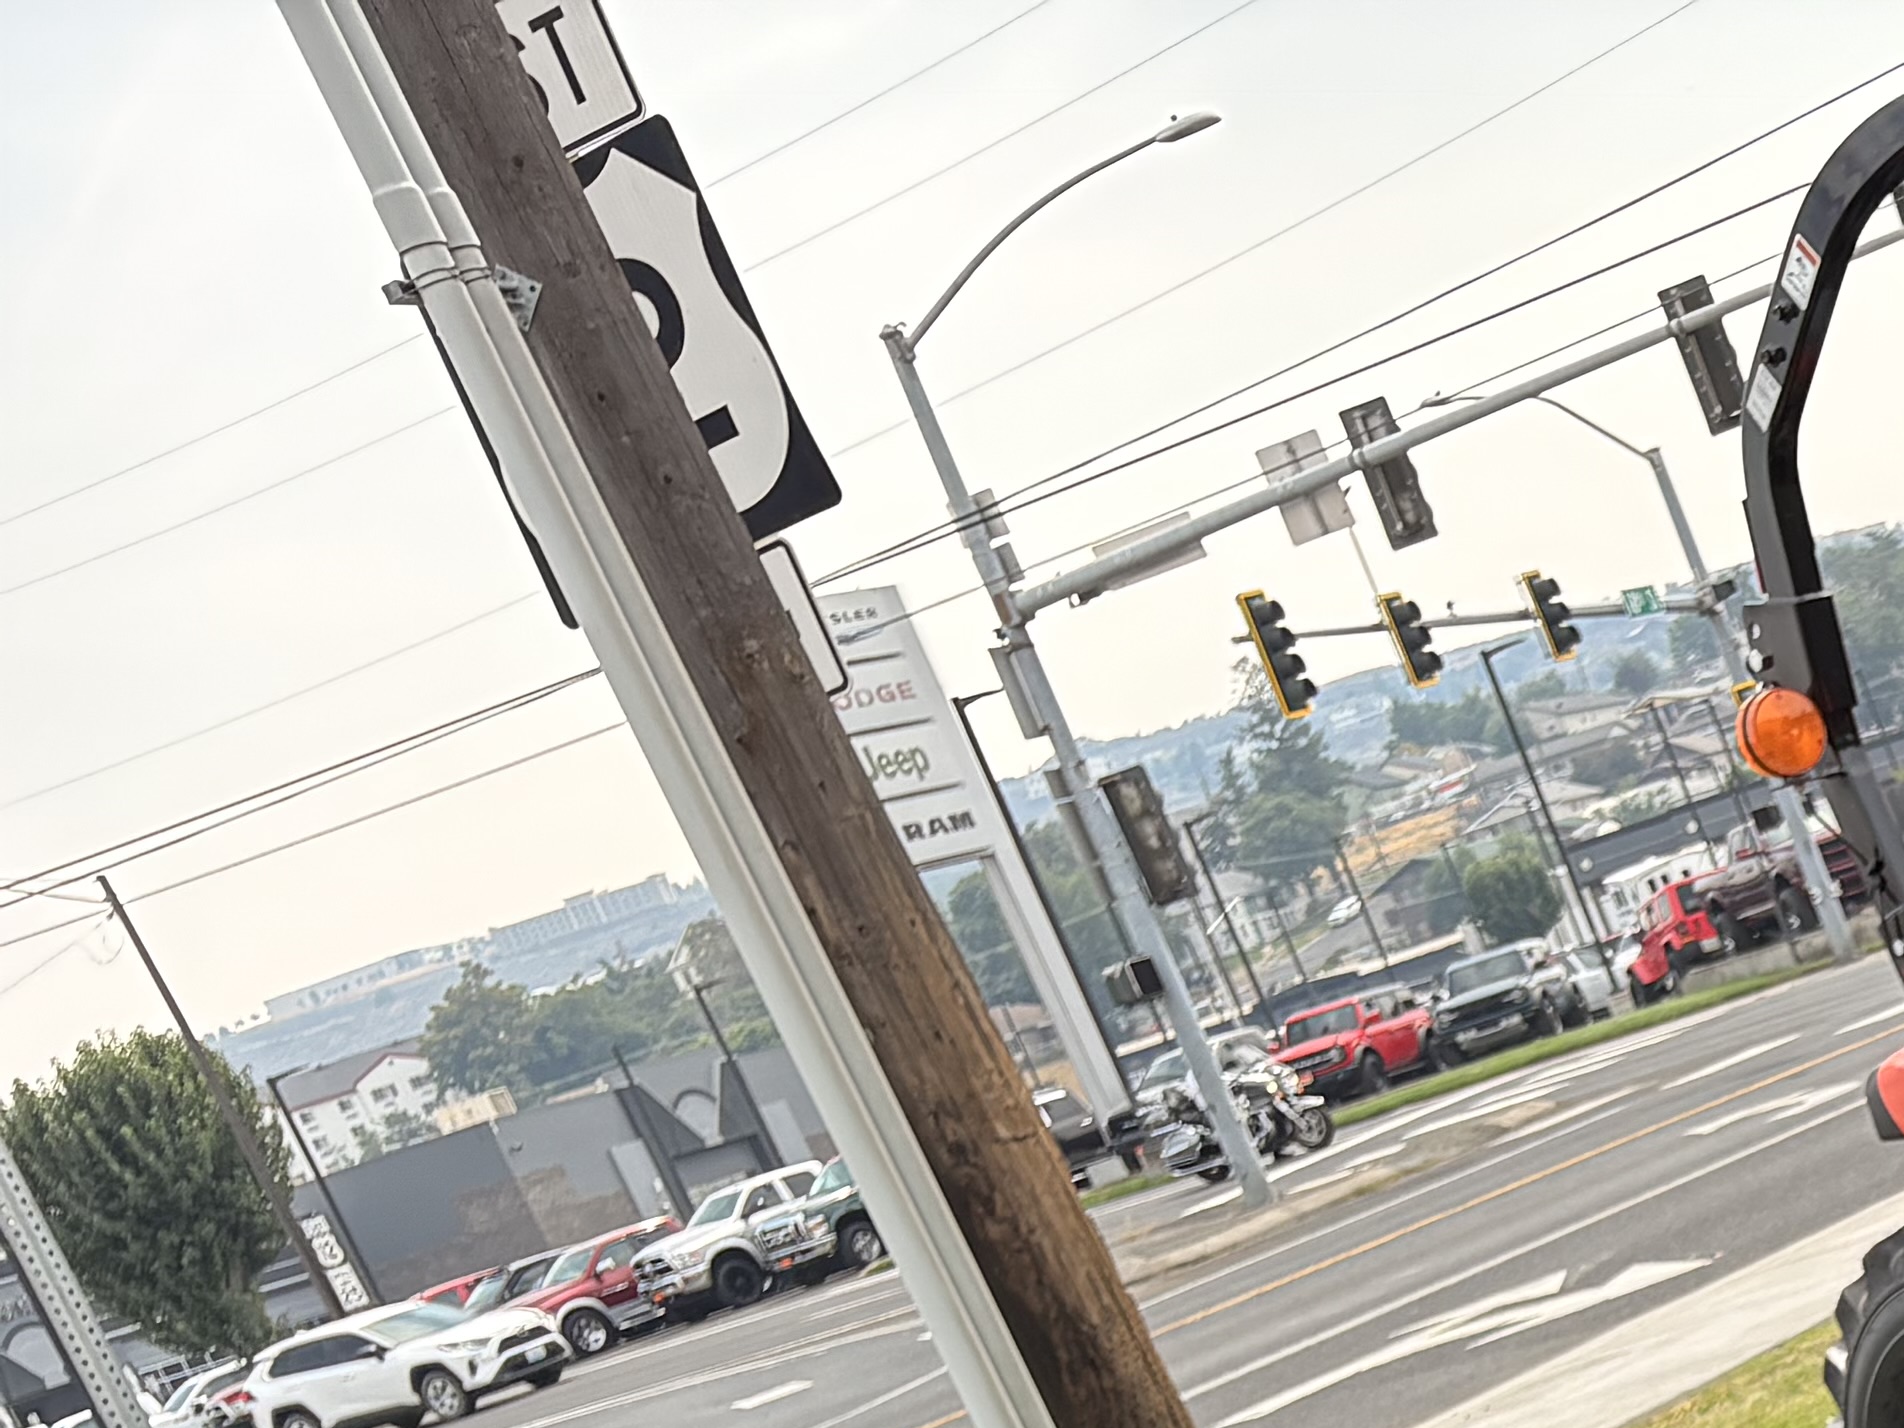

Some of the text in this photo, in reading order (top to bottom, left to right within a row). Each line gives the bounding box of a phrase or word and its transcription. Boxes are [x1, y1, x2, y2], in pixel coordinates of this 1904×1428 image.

[828, 604, 879, 627] SLER
[833, 680, 917, 712] ODGE
[865, 745, 930, 783] Jeep
[902, 808, 976, 843] RAM
